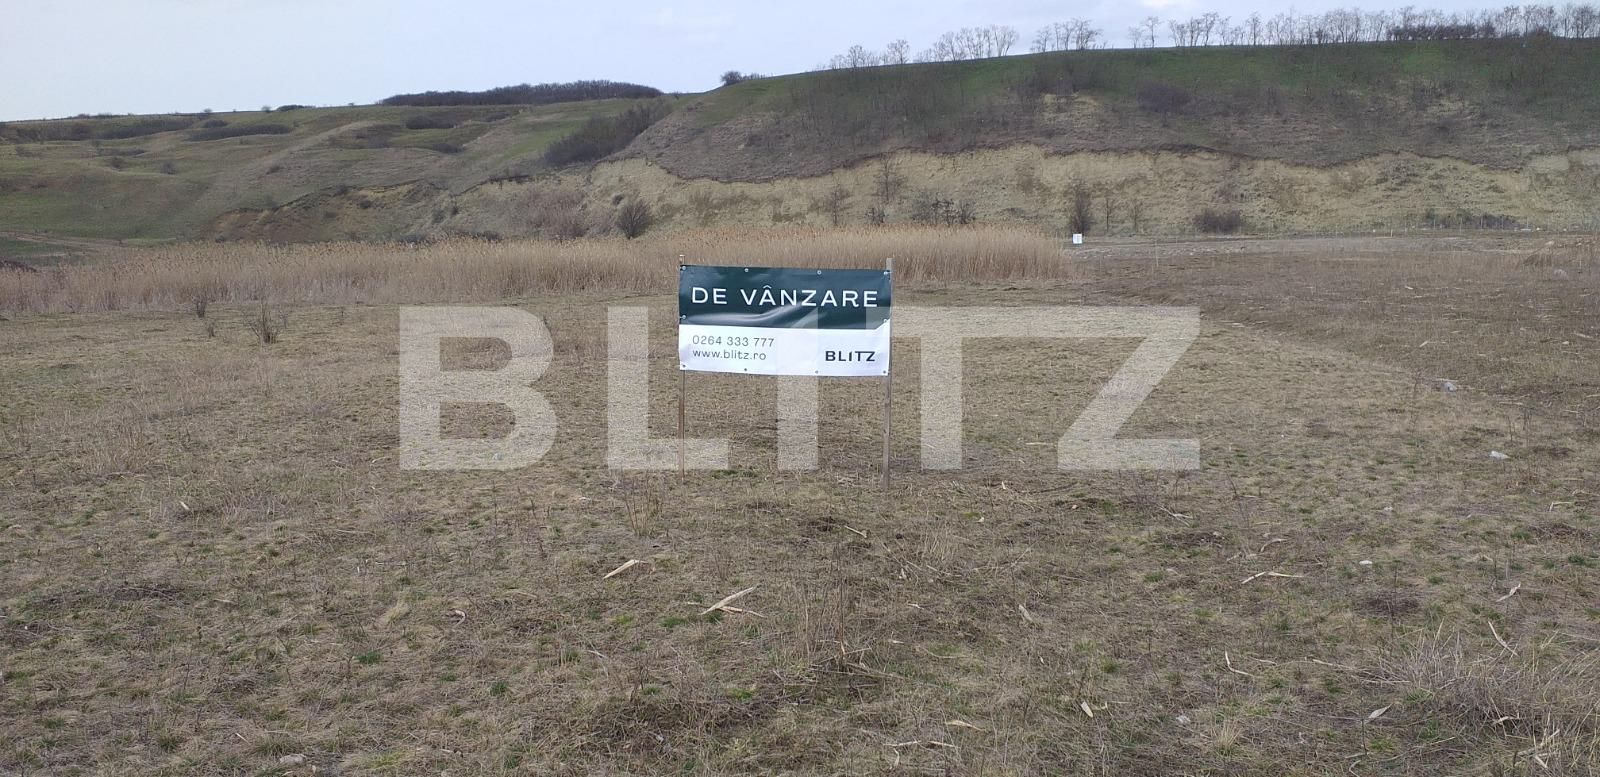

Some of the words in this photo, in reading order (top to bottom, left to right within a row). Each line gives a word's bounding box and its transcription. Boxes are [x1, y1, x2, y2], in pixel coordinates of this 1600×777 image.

[691, 286, 728, 305] DE
[740, 284, 878, 308] VÂNZARE
[692, 335, 722, 346] 0264
[726, 336, 749, 347] 333
[753, 337, 775, 348] 777
[692, 349, 767, 361] www.blitz.ro
[825, 350, 876, 362] BLITZ
